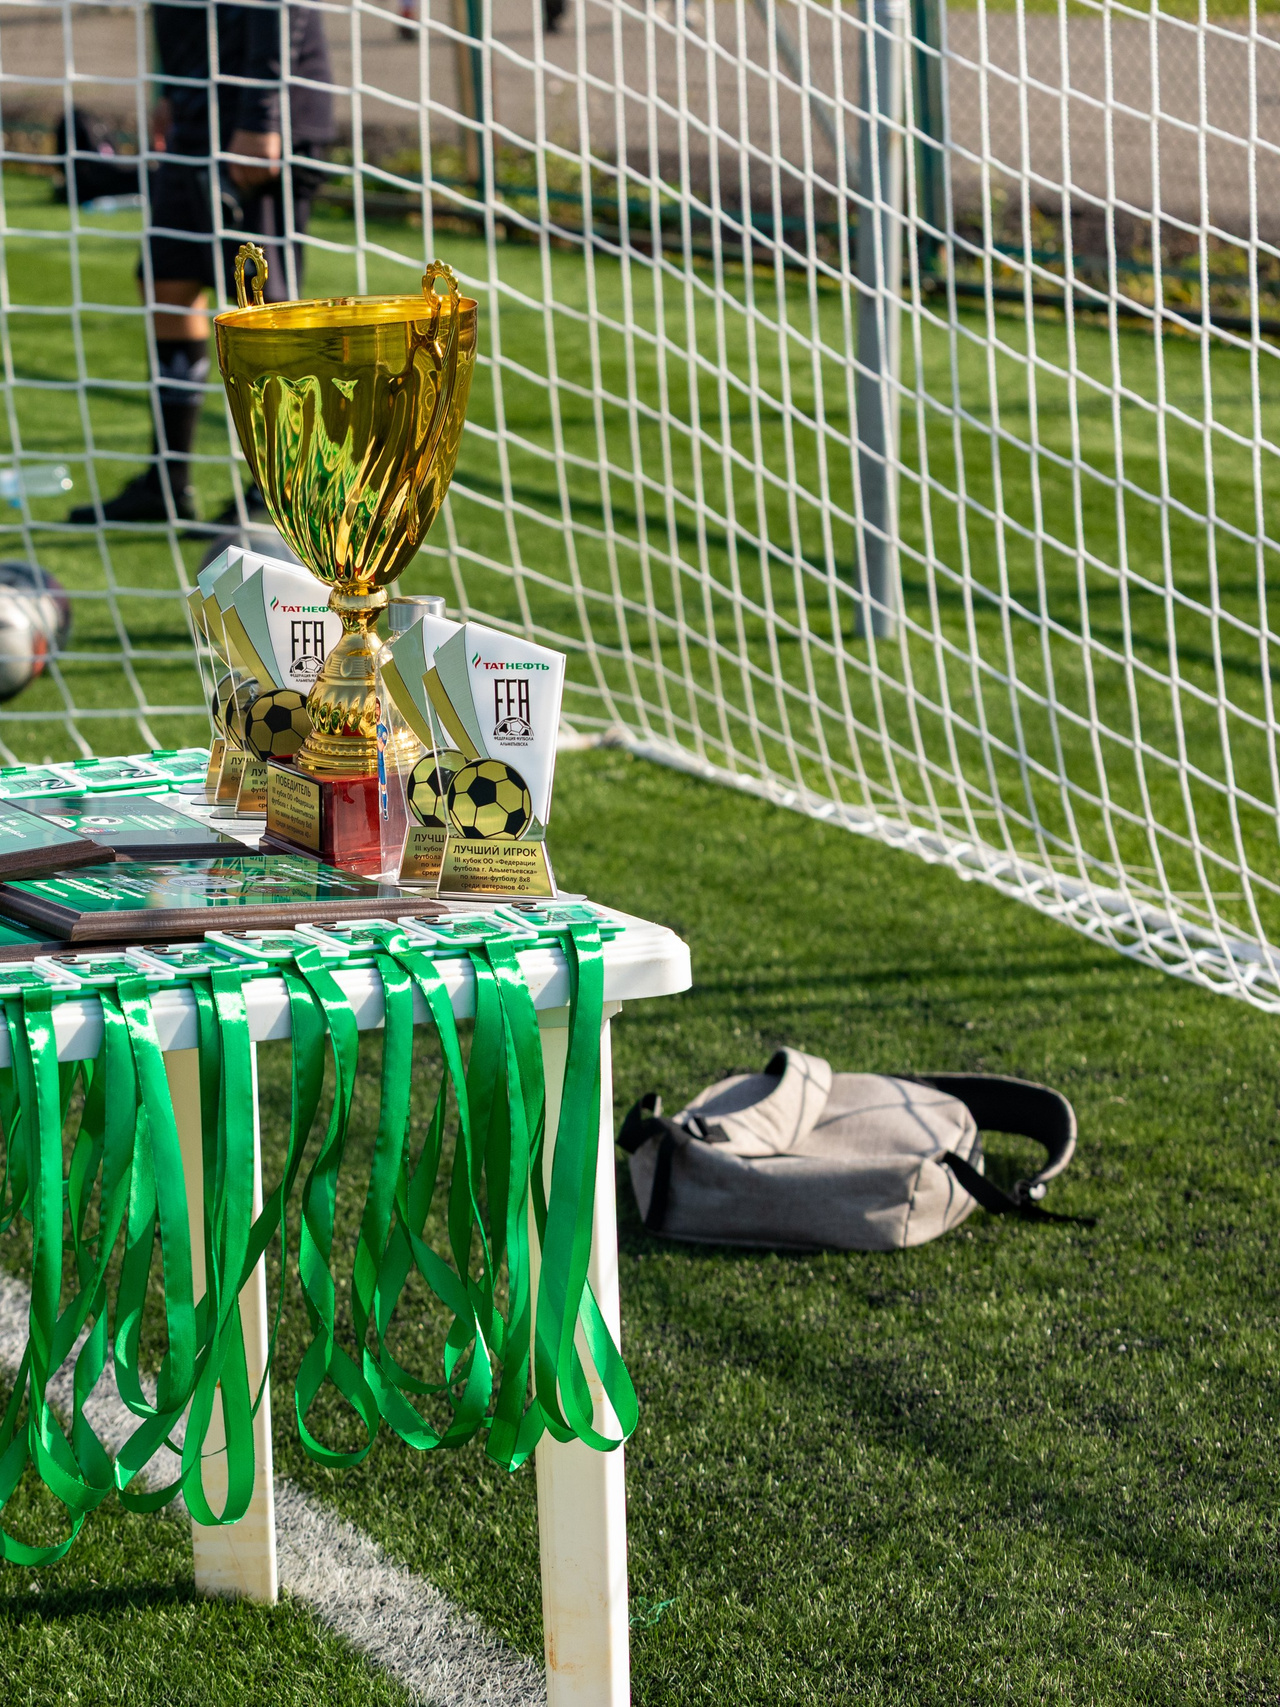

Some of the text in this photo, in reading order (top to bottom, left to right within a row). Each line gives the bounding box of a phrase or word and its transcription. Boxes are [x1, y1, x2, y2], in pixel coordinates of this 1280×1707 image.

[281, 605, 329, 613] ТАТНЕФ
[291, 620, 325, 663] FFA
[483, 662, 550, 671] ТАТНЕФТЬ
[493, 678, 531, 725] FFA
[276, 774, 312, 797] ПОБЕДИТЕЛЬ
[277, 790, 287, 798] кубок
[272, 797, 287, 808] футбола
[453, 845, 537, 857] ЛУЧШИЙ ИГРОК
[495, 858, 536, 867] «Федерации
[453, 865, 480, 873] футбола
[489, 866, 538, 875] Альметьевска»
[470, 875, 517, 883] мини-футболу
[461, 882, 480, 890] среди
[482, 883, 516, 891] ветеранов
